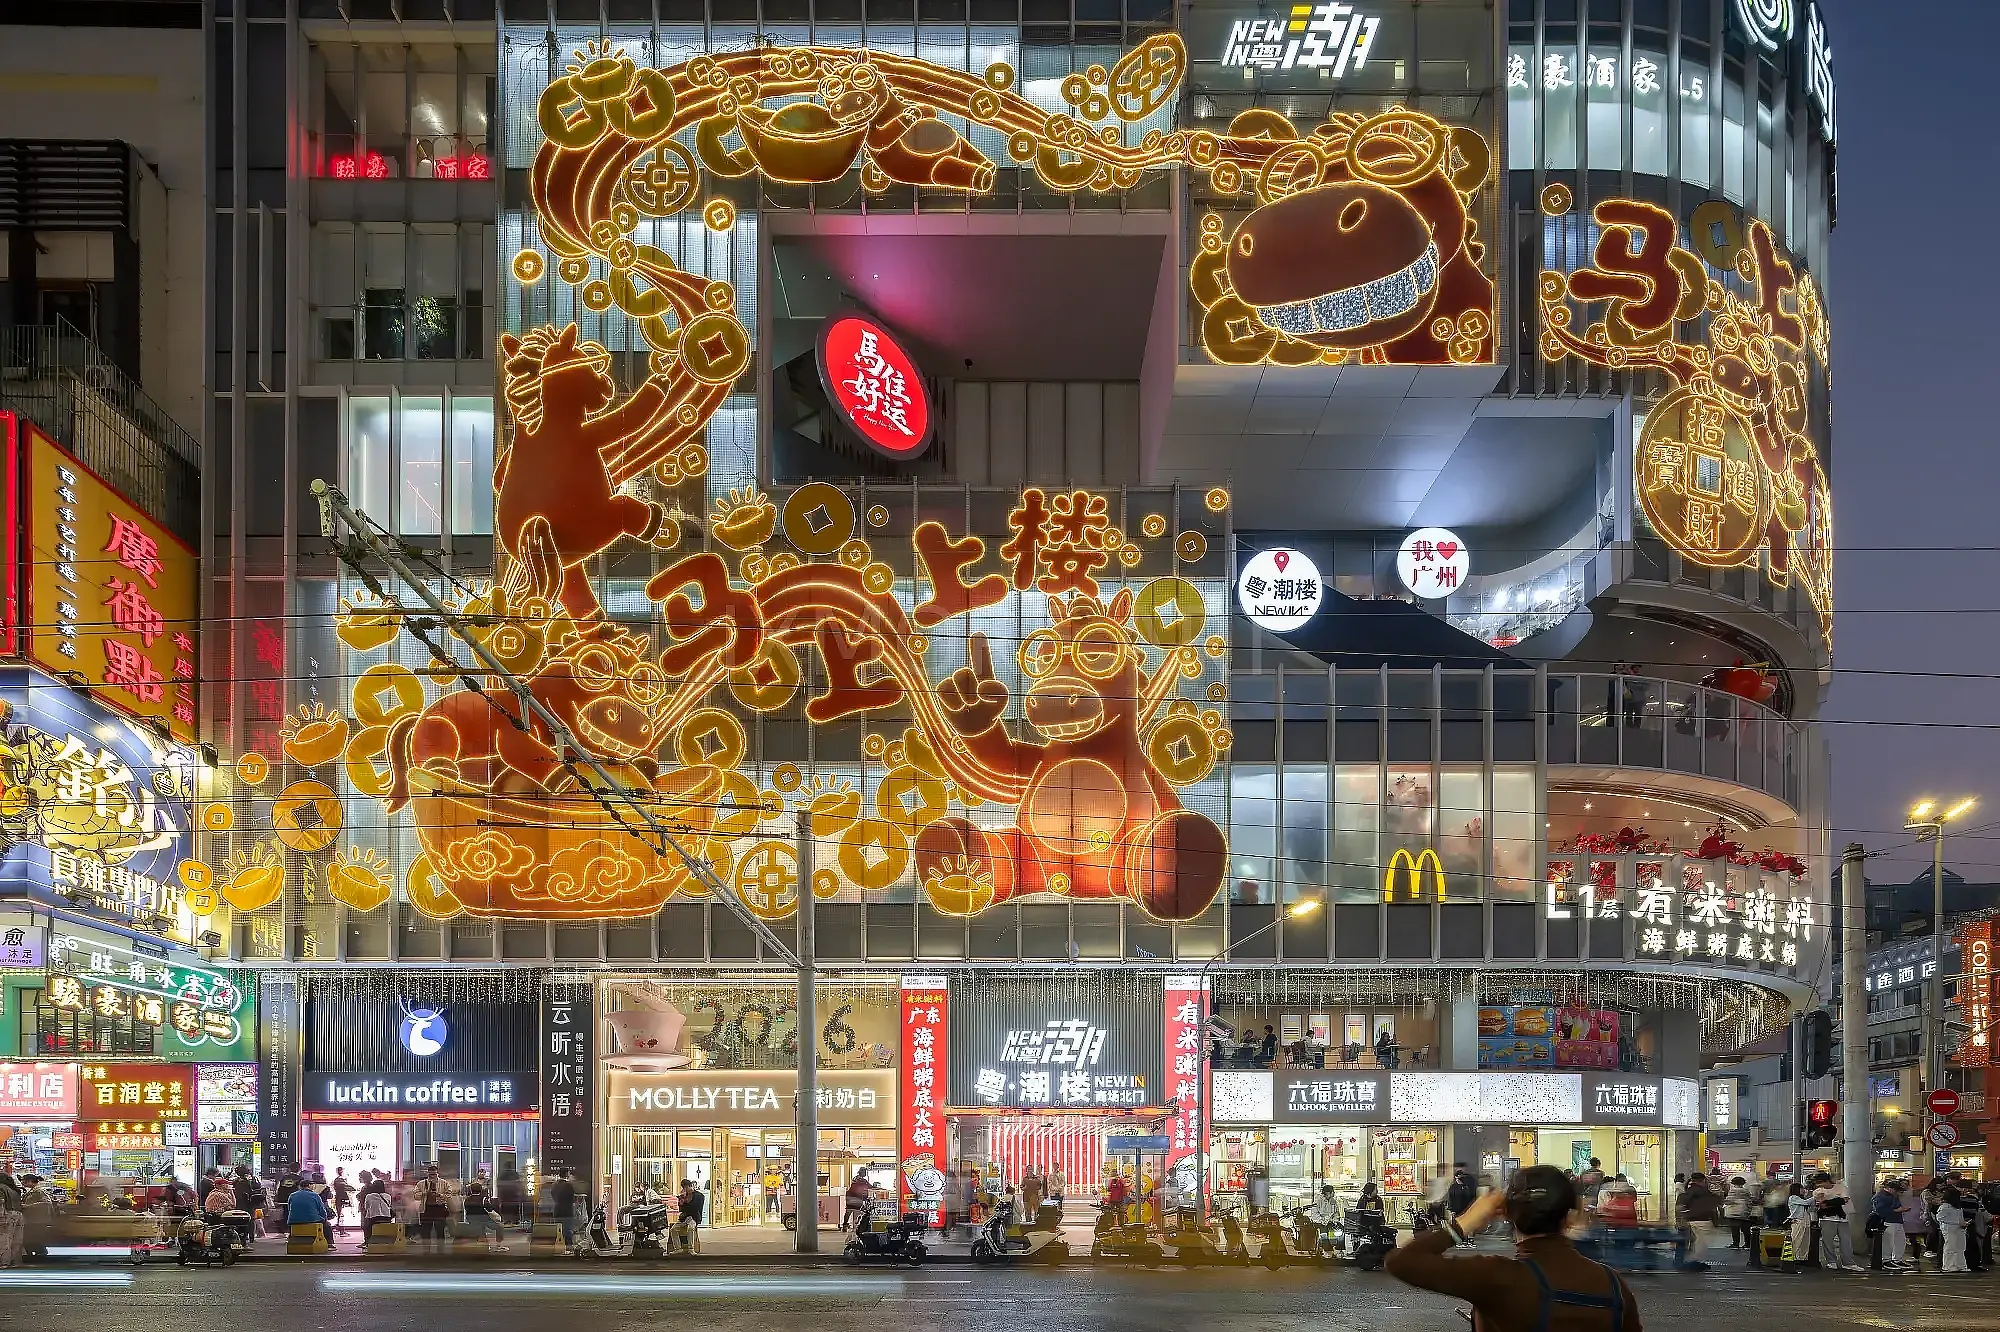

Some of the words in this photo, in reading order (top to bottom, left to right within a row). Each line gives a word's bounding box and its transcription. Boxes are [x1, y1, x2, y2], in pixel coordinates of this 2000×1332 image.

[1229, 20, 1288, 43] NEW
[1411, 540, 1434, 562] 我
[1411, 565, 1457, 588] 广州
[2, 928, 26, 947] 愈
[907, 1007, 942, 1026] 广东
[1007, 1030, 1046, 1047] NEW
[0, 1073, 64, 1099] 利店
[328, 1080, 398, 1104] luckin
[404, 1080, 479, 1105] coffee
[489, 1080, 512, 1093] 瑞幸
[912, 1027, 936, 1150] 海鲜粥底火锅
[1095, 1075, 1127, 1088] NEW
[1130, 1075, 1146, 1088] IN
[1287, 1080, 1378, 1103] 六福珠寶
[95, 1083, 166, 1105] 百润堂
[630, 1087, 722, 1110] MOLLY
[724, 1087, 782, 1110] TEA
[796, 1085, 877, 1110] 莉奶白
[1328, 1103, 1377, 1117] JEWELLERY
